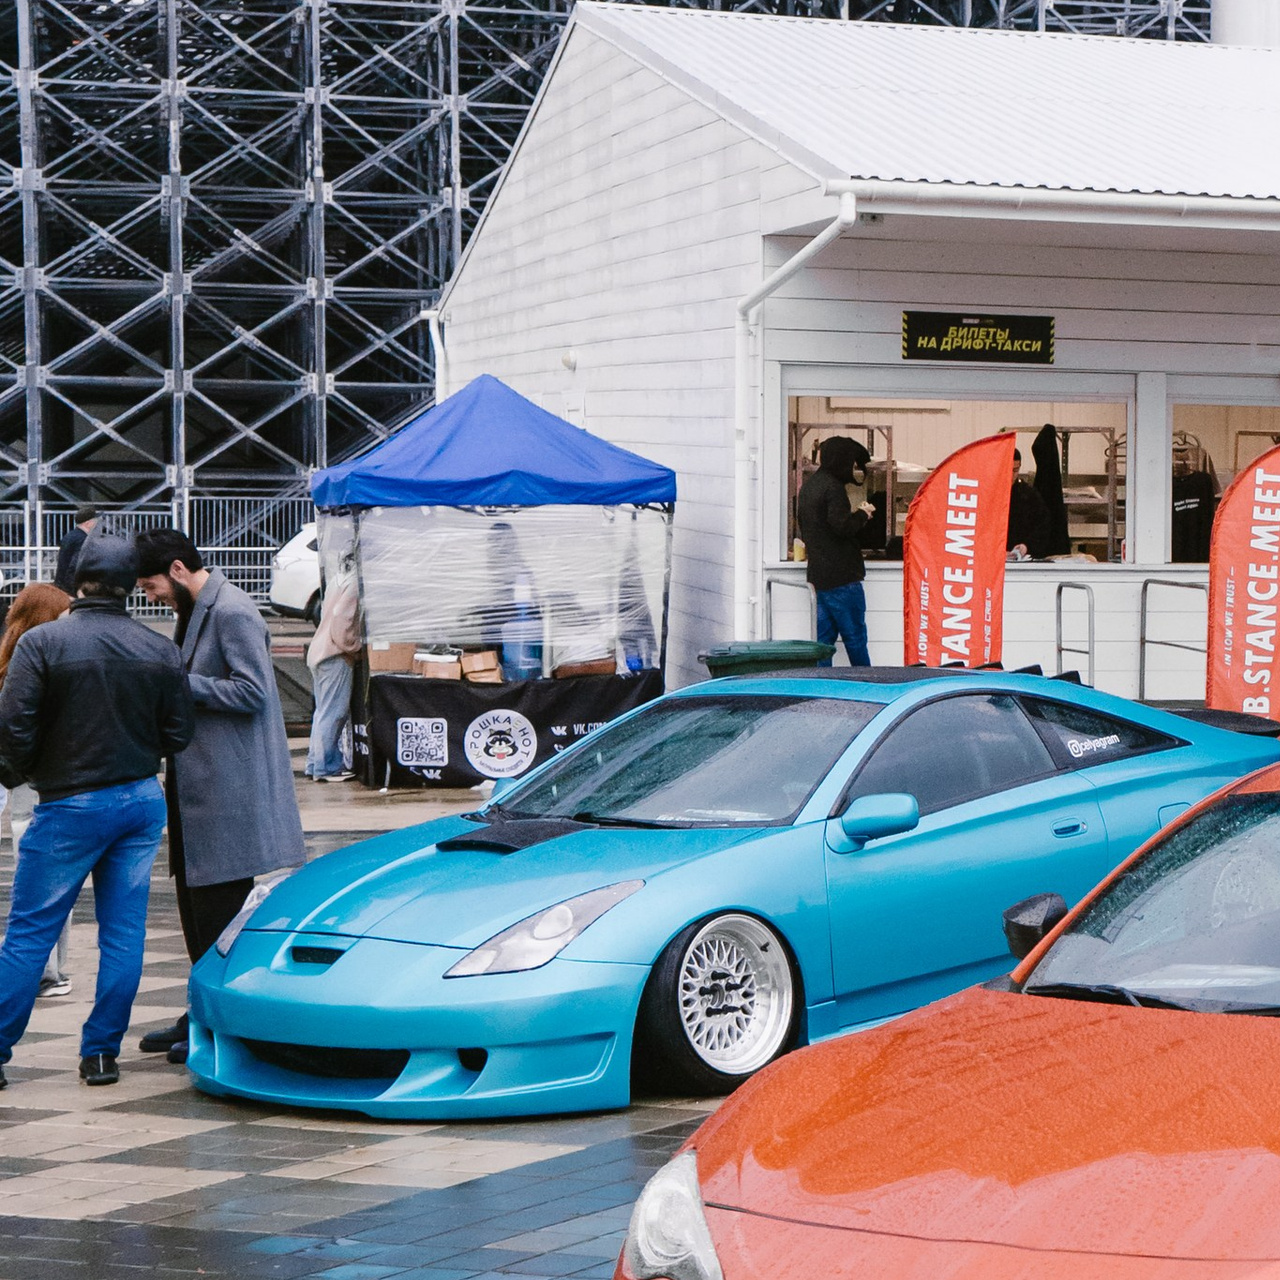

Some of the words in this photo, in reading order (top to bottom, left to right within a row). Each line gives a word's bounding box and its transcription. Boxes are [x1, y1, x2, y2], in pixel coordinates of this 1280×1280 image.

[947, 326, 1010, 340] БИЛЕТЫ
[917, 336, 937, 348] НА
[940, 337, 1042, 352] ДРИФТ-ТАКСИ
[920, 580, 929, 611] TRUST
[1225, 577, 1235, 608] TRUST
[919, 613, 929, 630] WE
[1225, 610, 1234, 626] WE
[918, 631, 928, 657] LOW
[1224, 628, 1233, 652] LOW
[1223, 653, 1232, 666] IN
